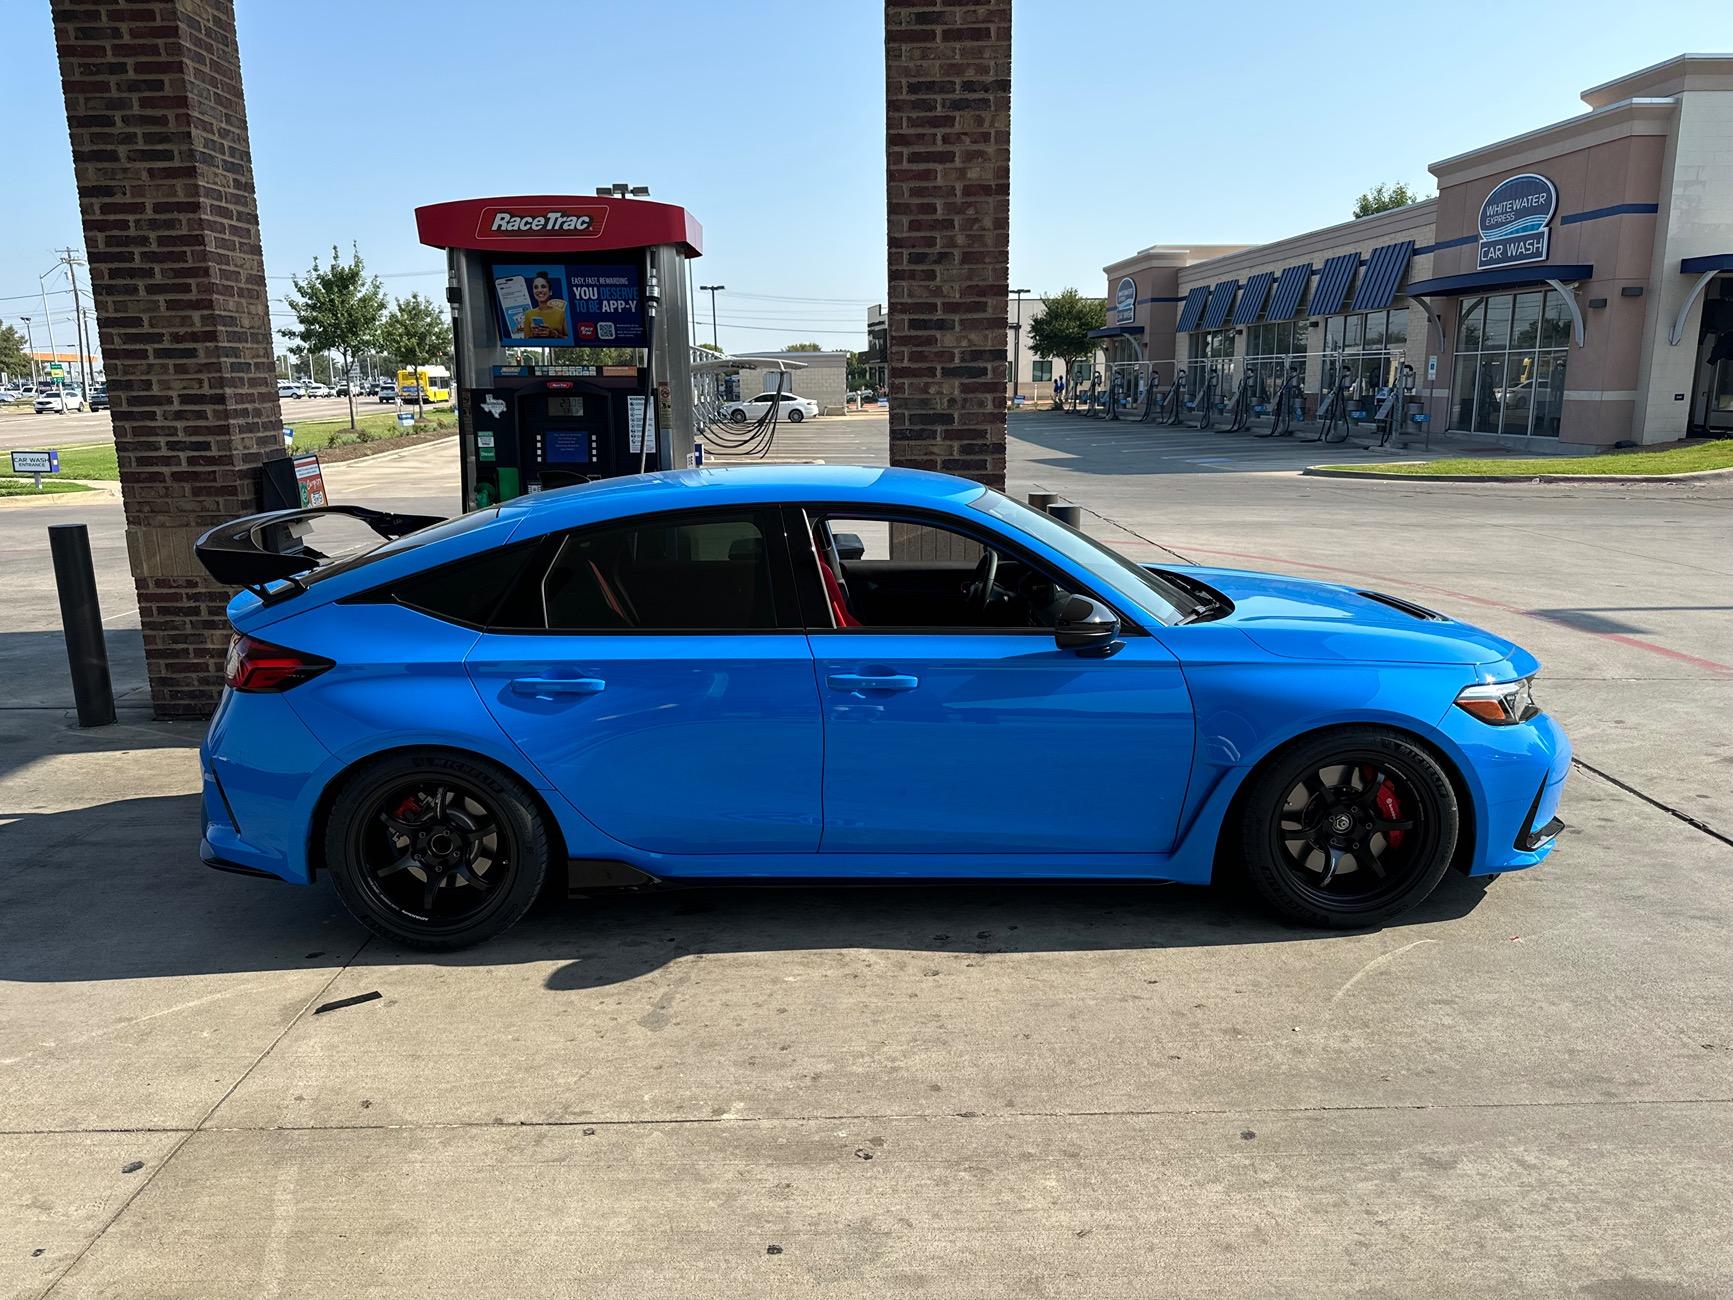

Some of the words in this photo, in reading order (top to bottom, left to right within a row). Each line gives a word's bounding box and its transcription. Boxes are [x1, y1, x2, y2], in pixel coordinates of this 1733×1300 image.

[1486, 193, 1547, 216] WHITEWATER
[491, 212, 590, 231] RaceTrac
[1485, 212, 1515, 226] EXPRESS
[1481, 245, 1503, 261] CAR
[1506, 238, 1543, 257] WASH
[571, 277, 585, 285] EASY,
[585, 277, 599, 285] FAST,
[573, 287, 598, 300] YOU
[600, 287, 639, 300] DESERVE
[575, 301, 587, 313] TO
[588, 301, 600, 313] BE
[601, 300, 637, 313] APP-Y
[1399, 744, 1450, 799] MICHELIN
